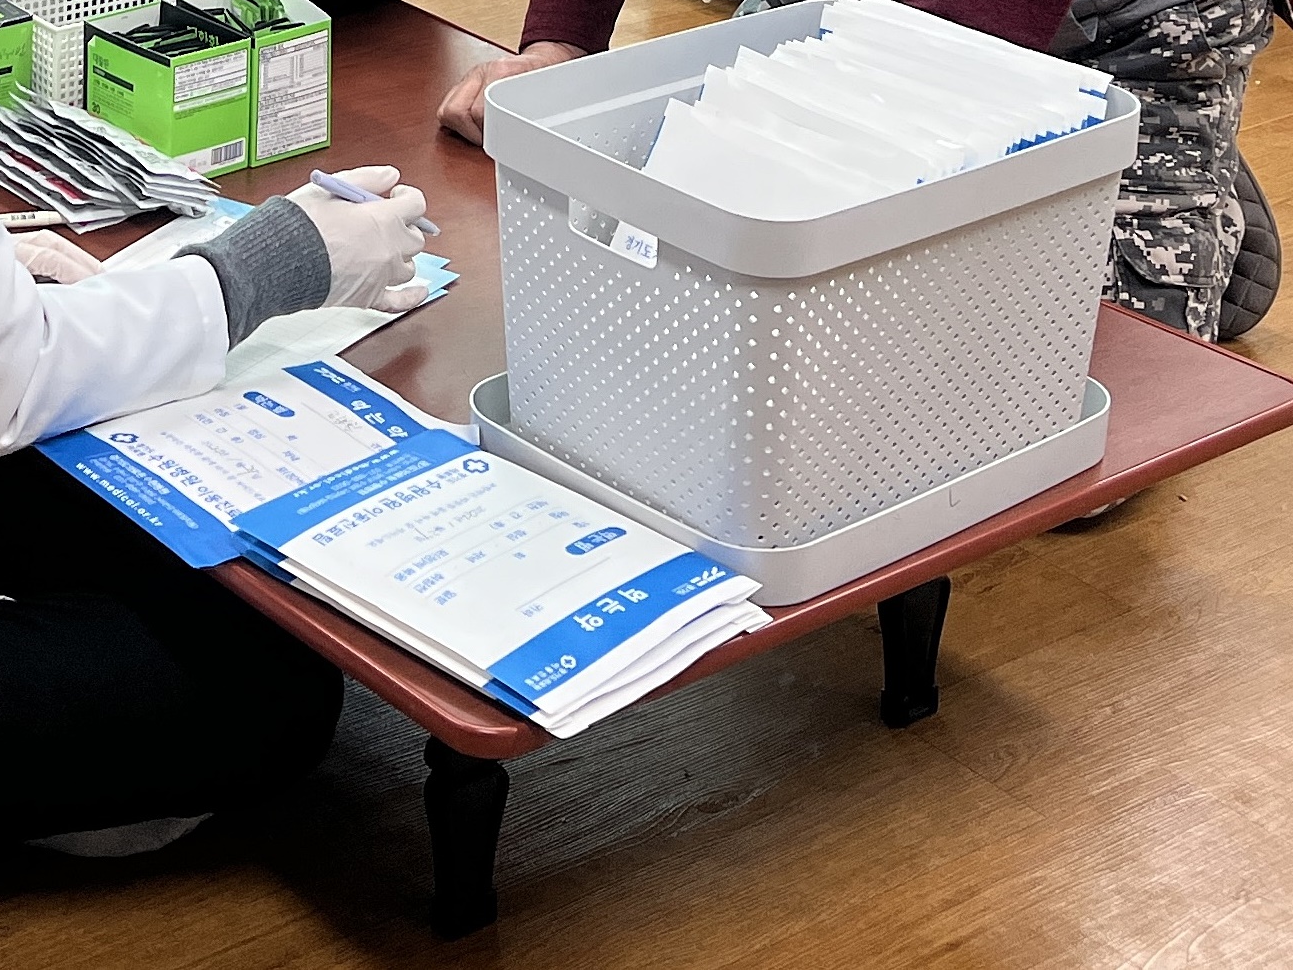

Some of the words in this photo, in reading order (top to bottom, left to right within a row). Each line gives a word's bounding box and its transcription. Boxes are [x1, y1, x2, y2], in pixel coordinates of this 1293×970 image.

[148, 454, 202, 486] 수원병원
[197, 486, 246, 518] 이동진료
[380, 480, 441, 510] 수원병원
[312, 507, 383, 546] 이동진료팀
